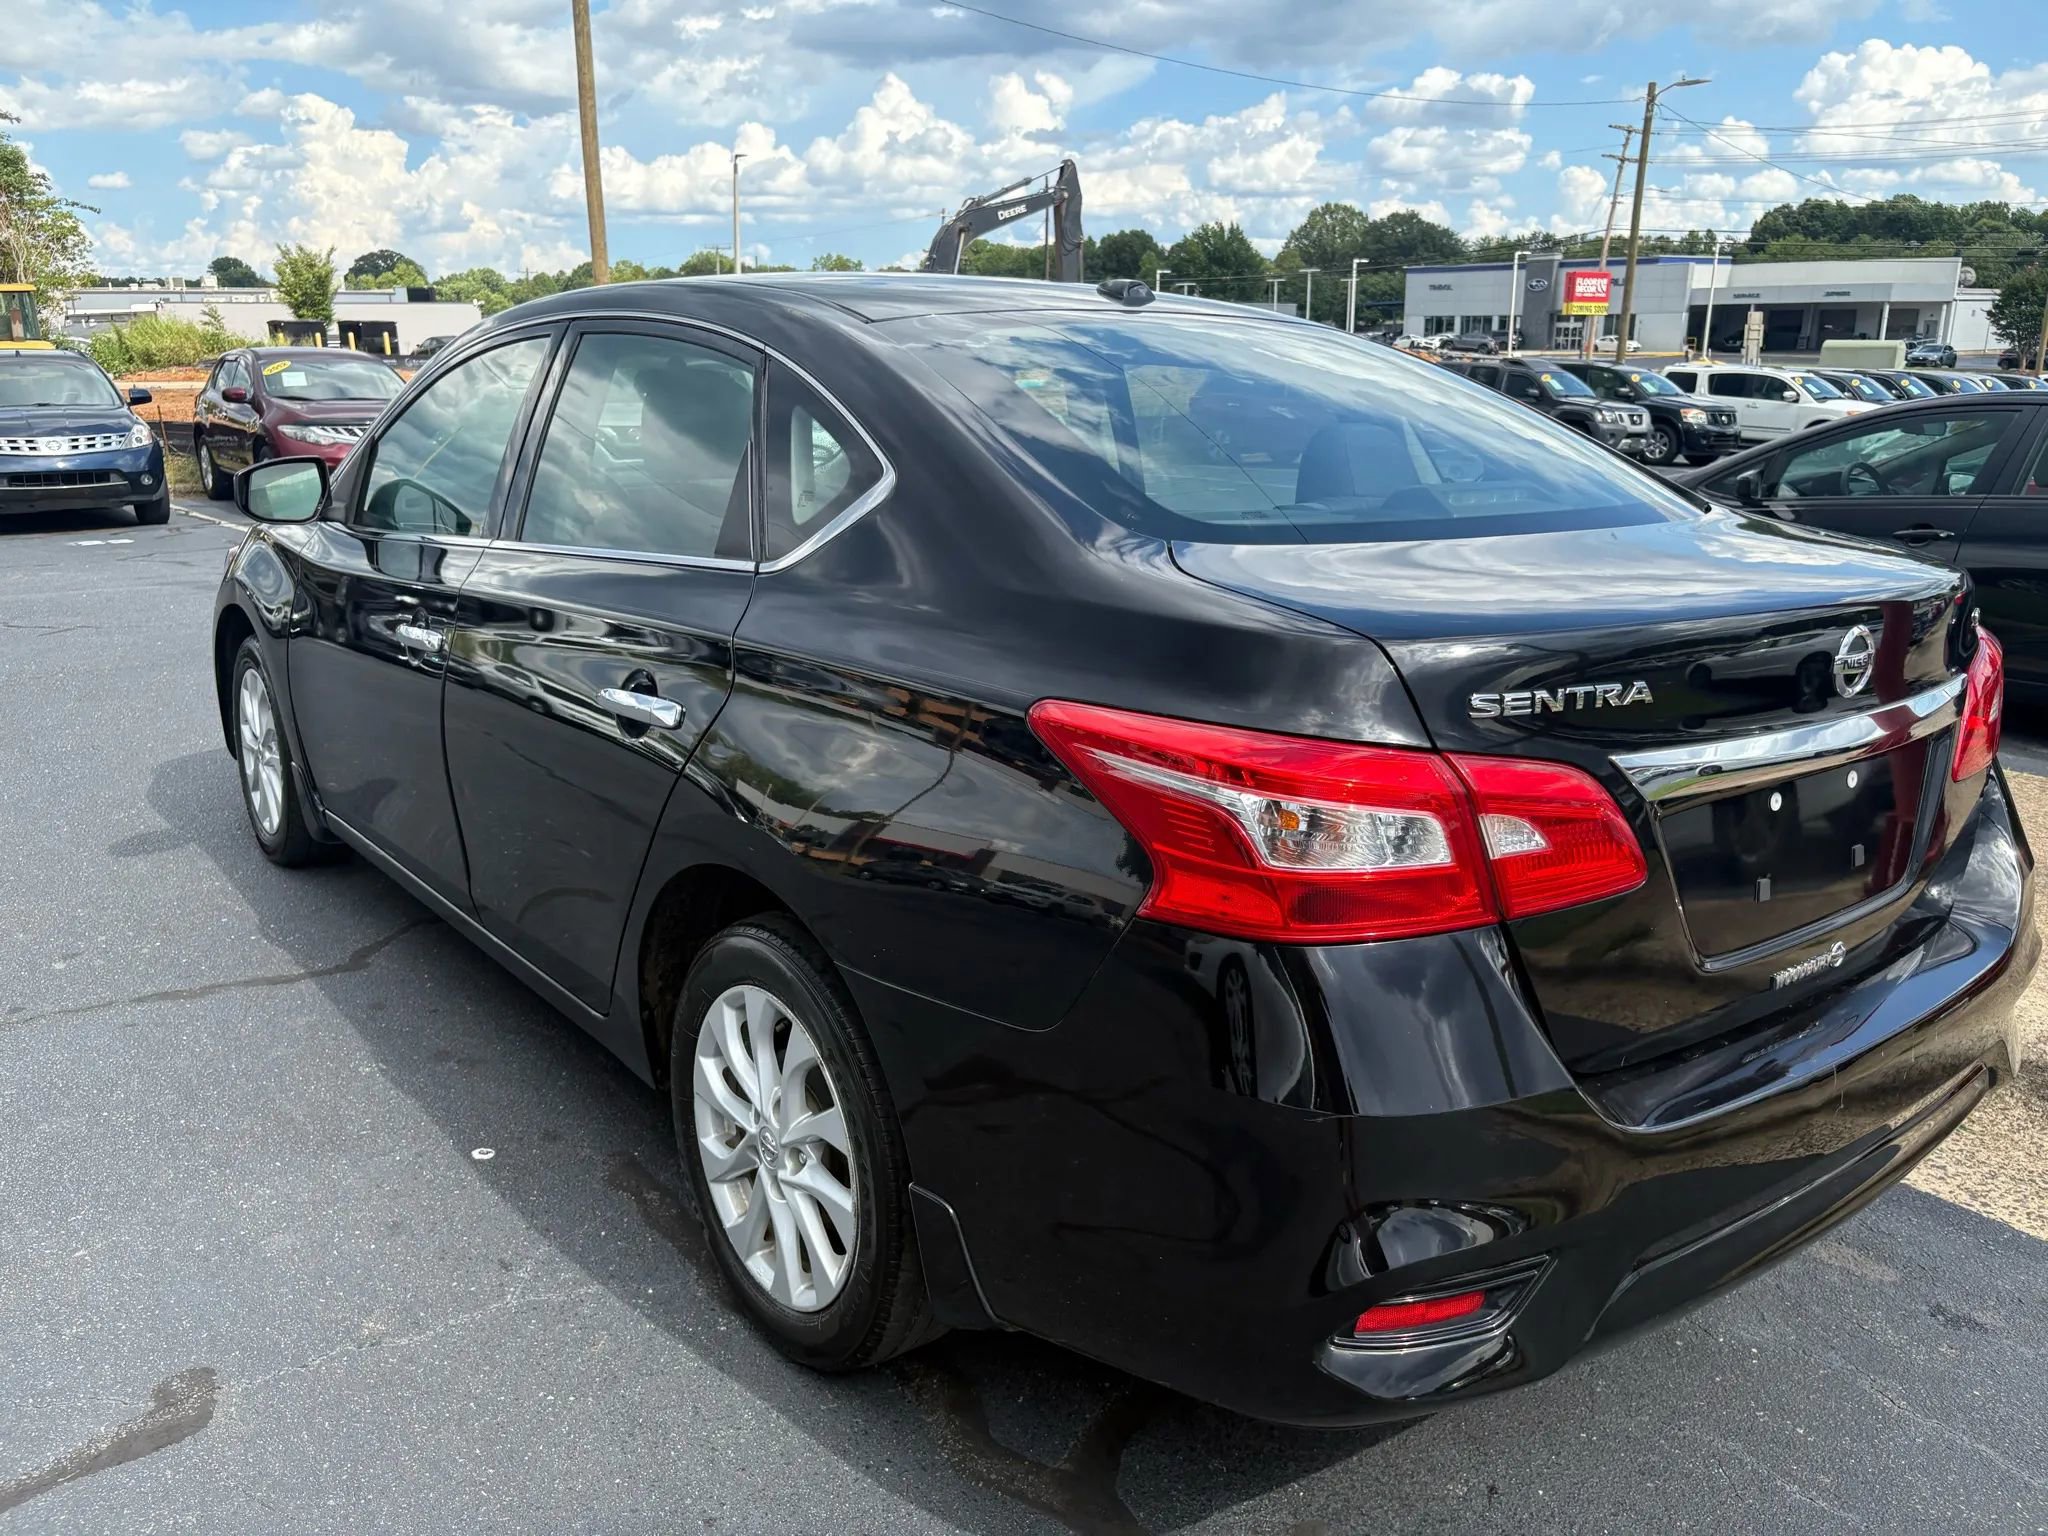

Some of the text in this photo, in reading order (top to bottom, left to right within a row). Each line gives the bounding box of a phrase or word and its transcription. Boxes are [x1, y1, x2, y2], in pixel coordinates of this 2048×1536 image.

[997, 204, 1028, 221] DEERE
[1572, 304, 1609, 313] COMING SOON
[1468, 680, 1654, 719] SENTRA
